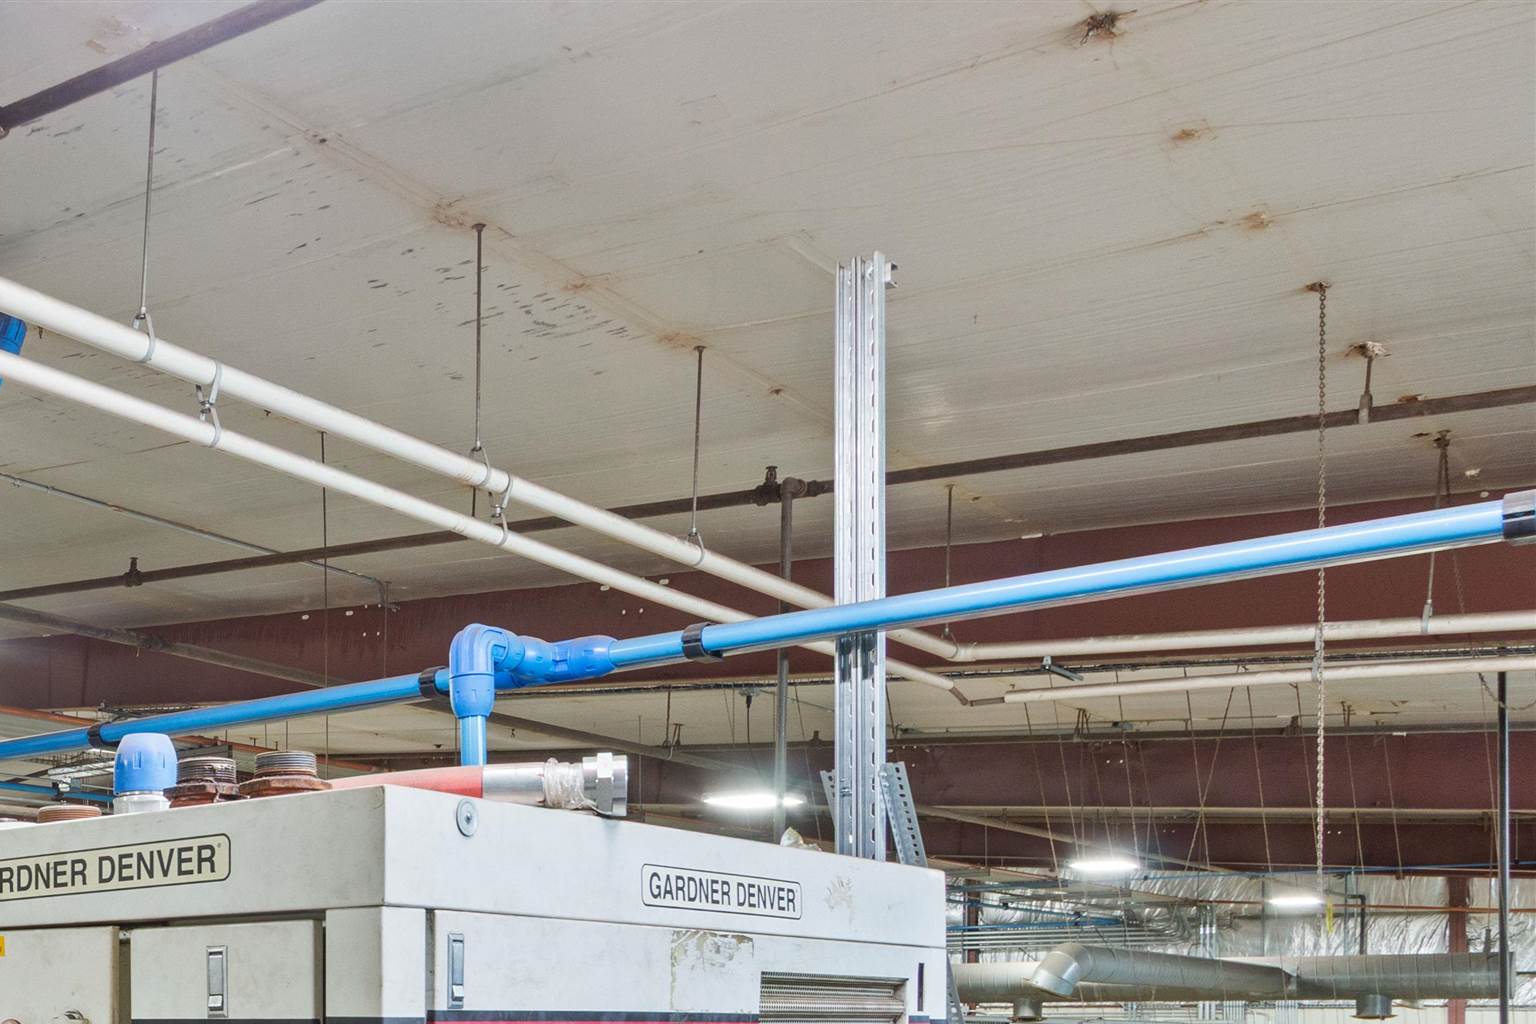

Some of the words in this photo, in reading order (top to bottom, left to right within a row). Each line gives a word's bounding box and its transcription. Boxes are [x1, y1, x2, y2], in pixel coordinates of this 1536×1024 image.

[98, 844, 216, 884] DENVER
[649, 872, 731, 906] GARDNER
[736, 882, 796, 912] DENVER
